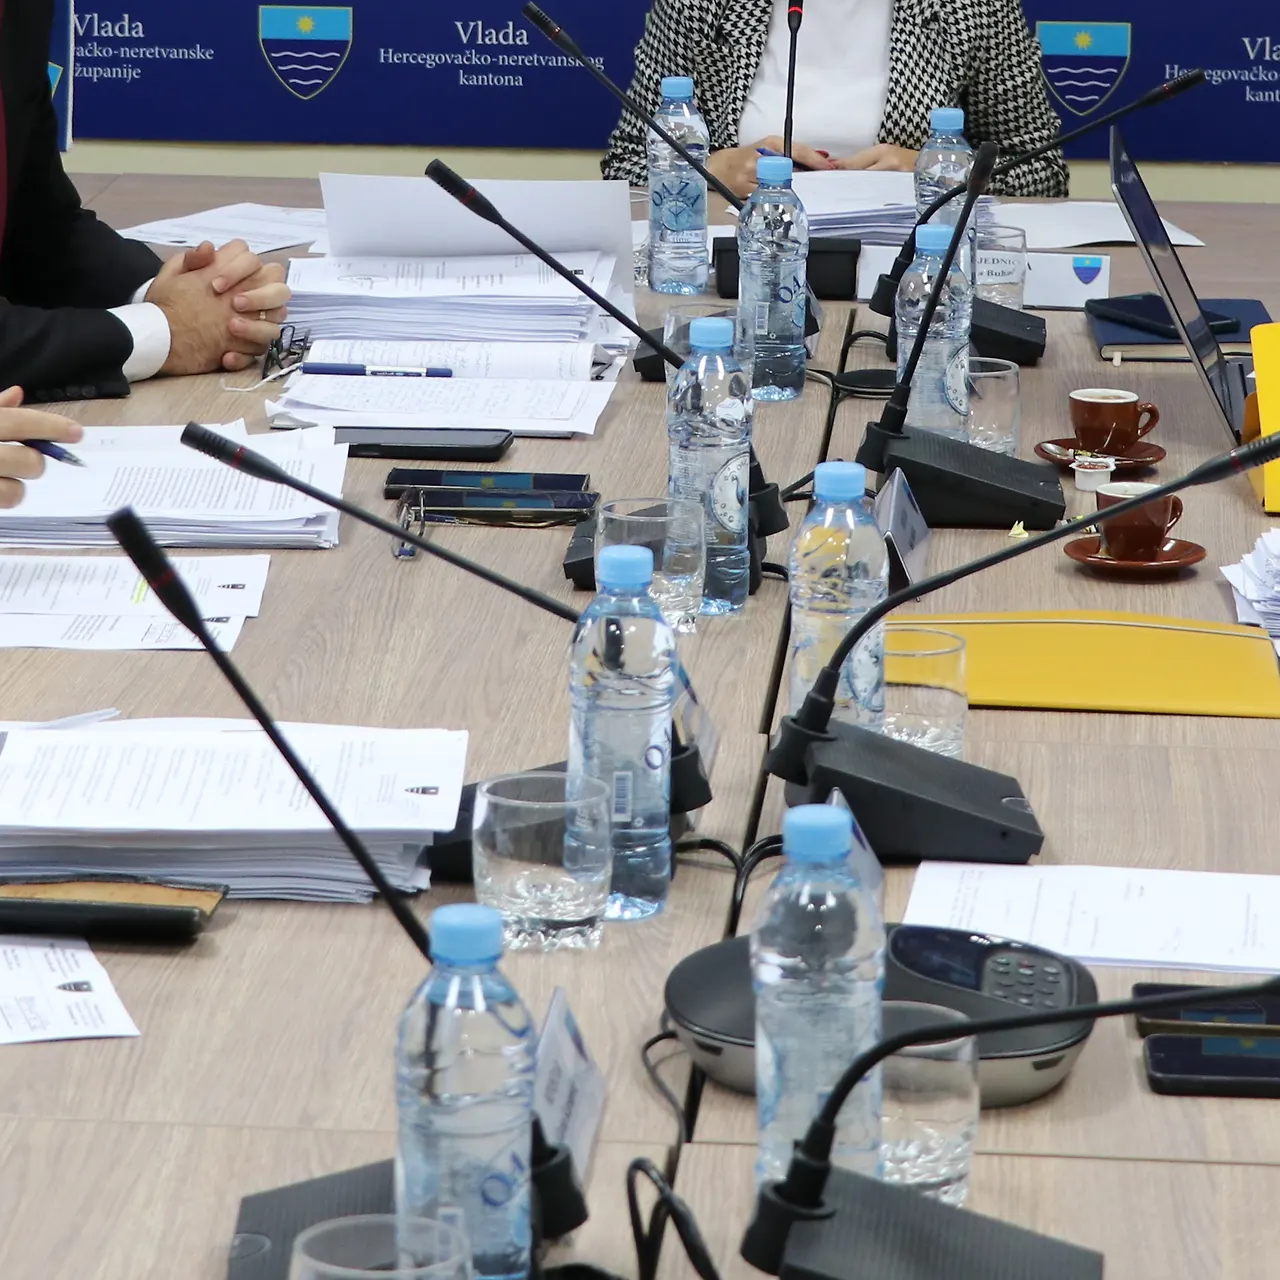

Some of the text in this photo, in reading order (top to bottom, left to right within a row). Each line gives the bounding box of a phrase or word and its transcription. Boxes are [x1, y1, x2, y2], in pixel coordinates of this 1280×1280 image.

[73, 13, 144, 38] Vlada
[455, 21, 529, 46] Vlada
[74, 63, 141, 83] županije
[459, 70, 523, 86] kantona
